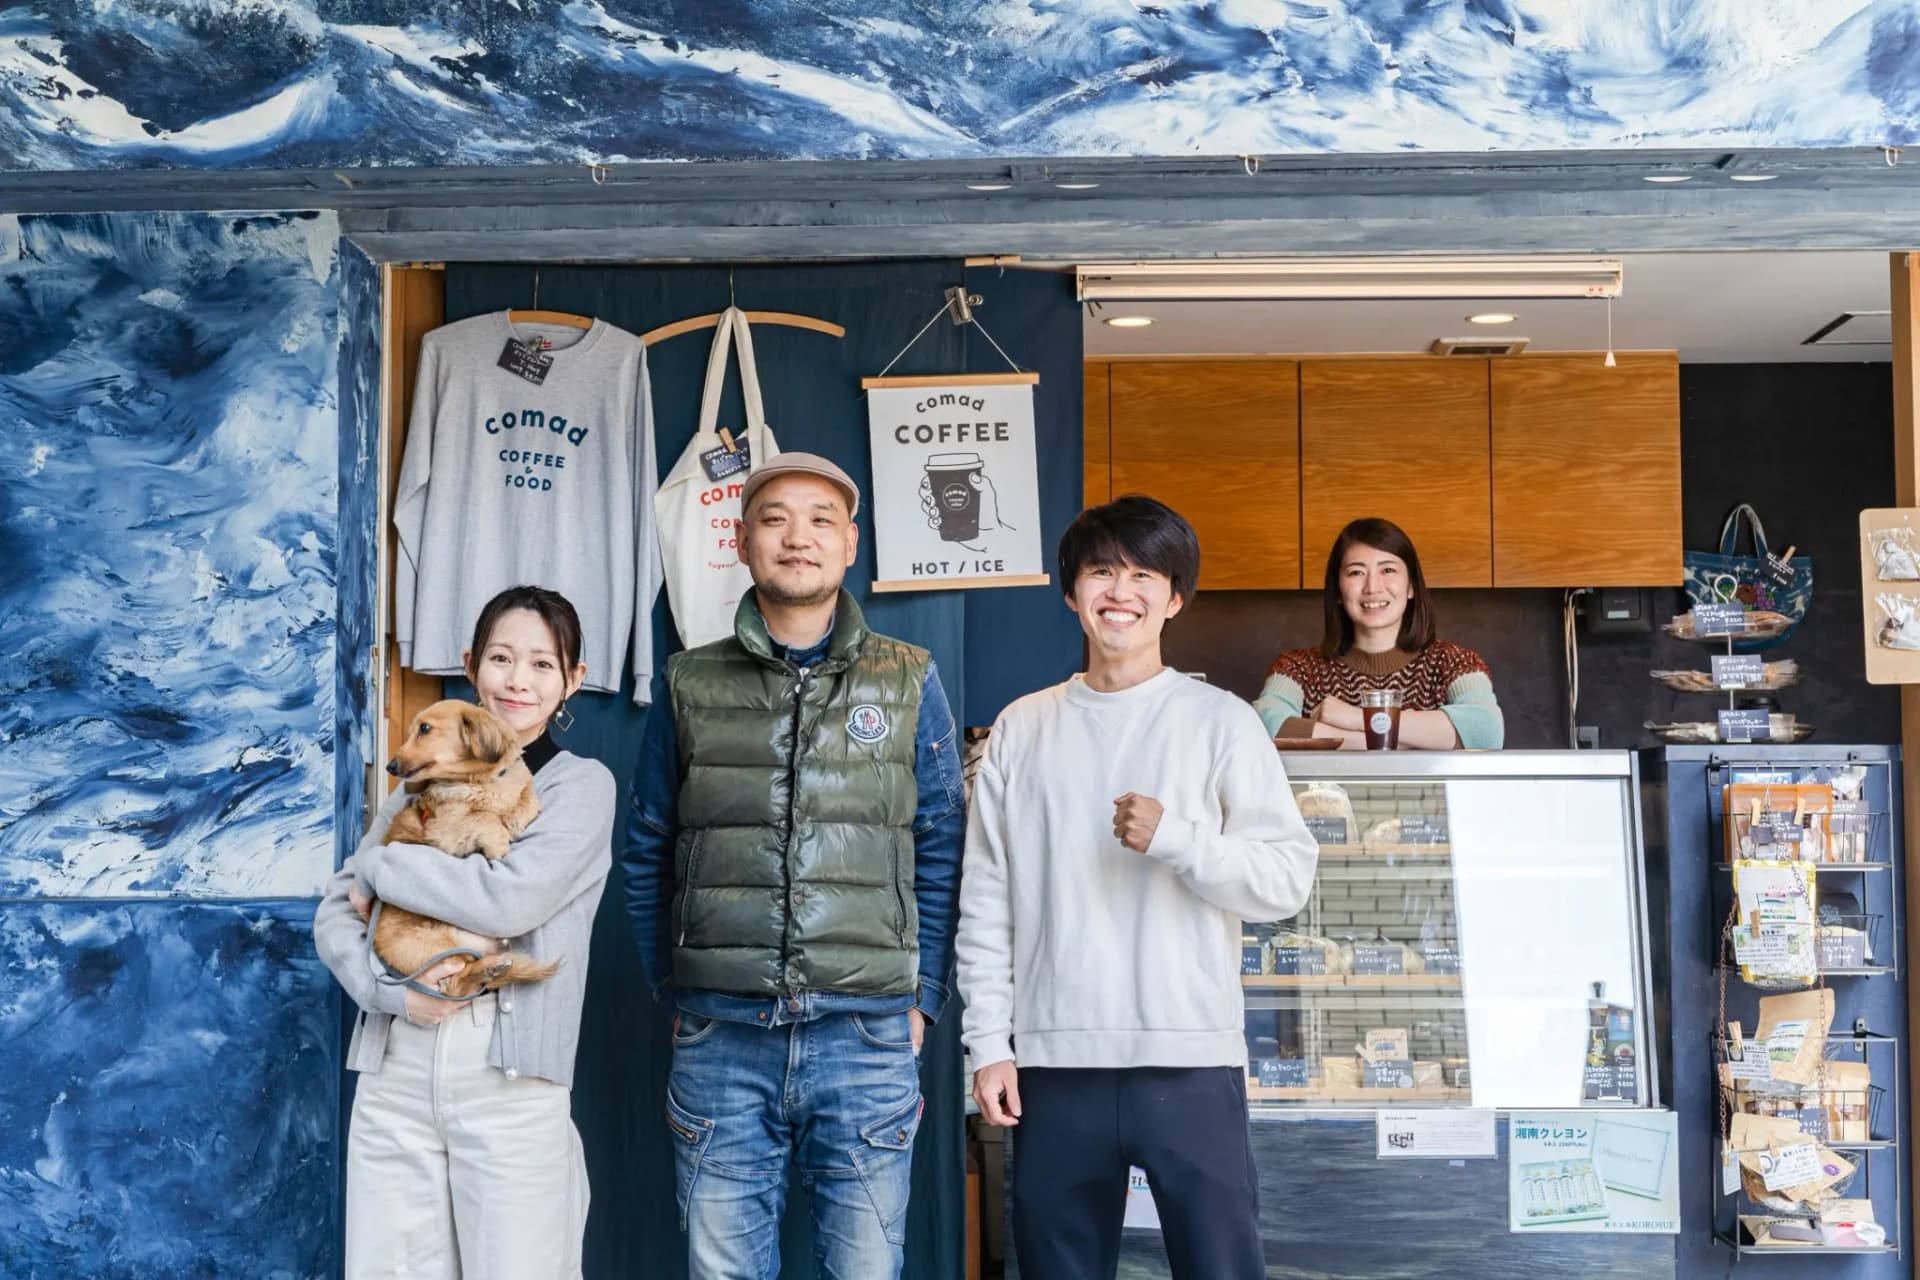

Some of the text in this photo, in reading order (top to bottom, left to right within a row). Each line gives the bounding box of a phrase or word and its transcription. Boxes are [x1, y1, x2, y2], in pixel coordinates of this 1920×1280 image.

[916, 393, 985, 413] comad
[485, 409, 588, 447] comad
[894, 422, 1010, 444] COFFEE
[499, 449, 565, 468] COFFEE
[505, 474, 552, 491] FOOD
[700, 483, 744, 505] com
[912, 562, 950, 575] HOT
[975, 560, 1004, 573] ICE
[1515, 1127, 1588, 1140] 湘南クレヨン
